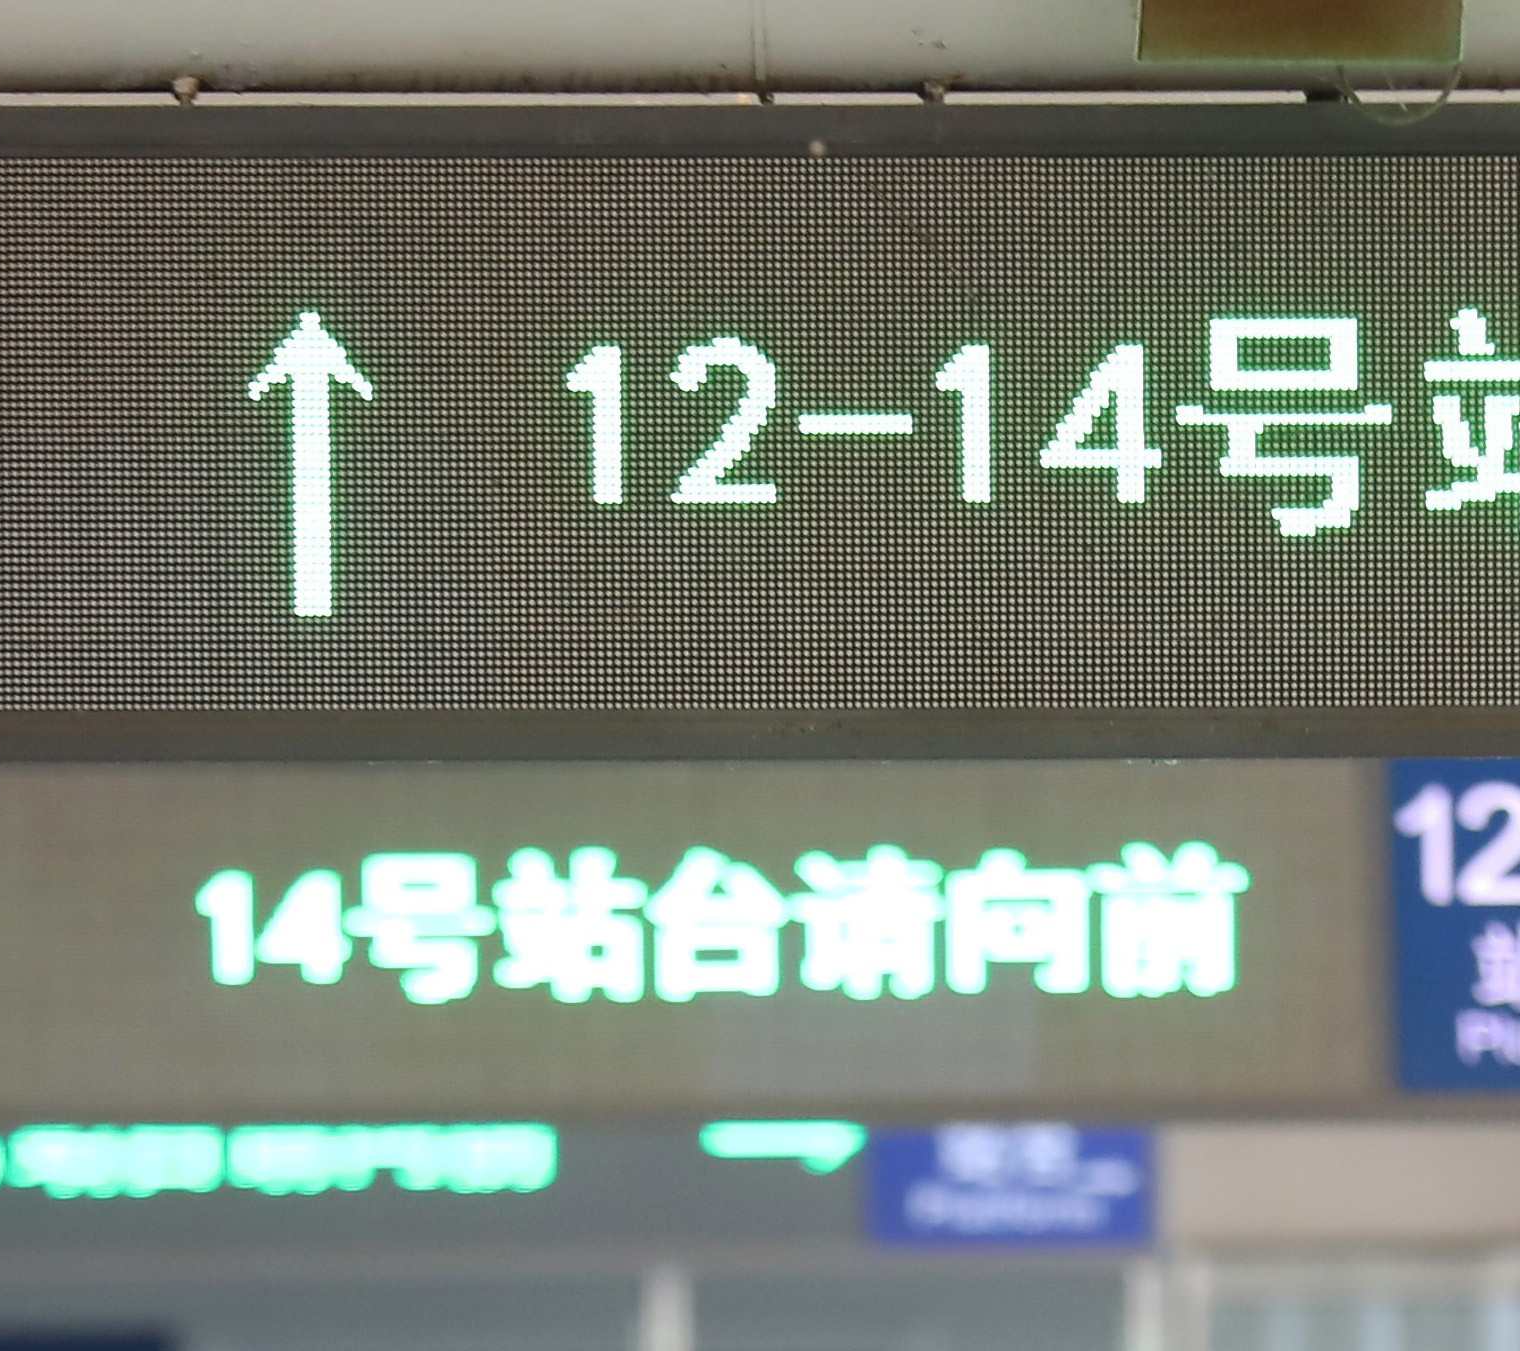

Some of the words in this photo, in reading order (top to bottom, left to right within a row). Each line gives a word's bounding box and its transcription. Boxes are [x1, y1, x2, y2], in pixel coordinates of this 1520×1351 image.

[196, 845, 1251, 1004] 14号站台请向前
